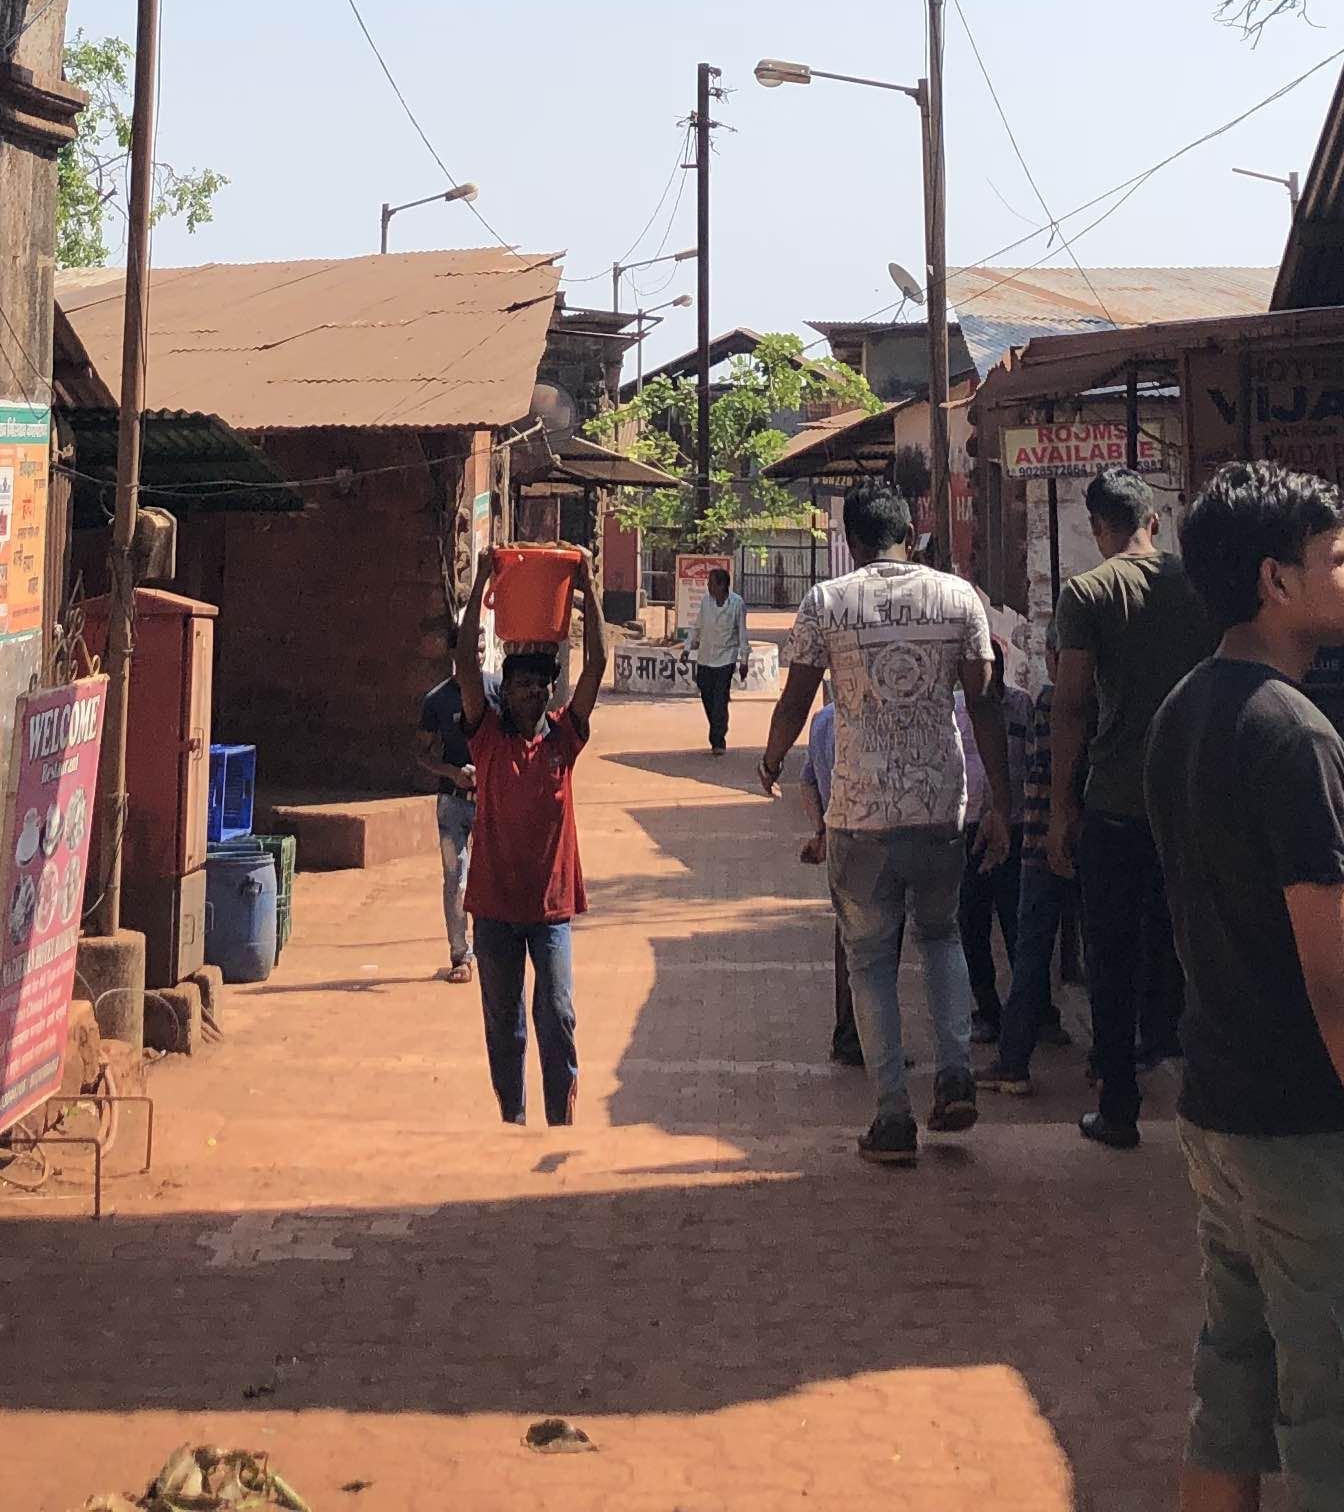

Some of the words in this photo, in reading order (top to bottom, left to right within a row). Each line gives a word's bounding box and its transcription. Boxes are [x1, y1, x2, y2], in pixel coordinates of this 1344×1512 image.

[1037, 423, 1126, 444] ROOMS
[1015, 440, 1154, 465] AVAILABE
[635, 651, 699, 686] माथेरा
[29, 695, 101, 763] WELCOME
[41, 753, 79, 785] Restaurant
